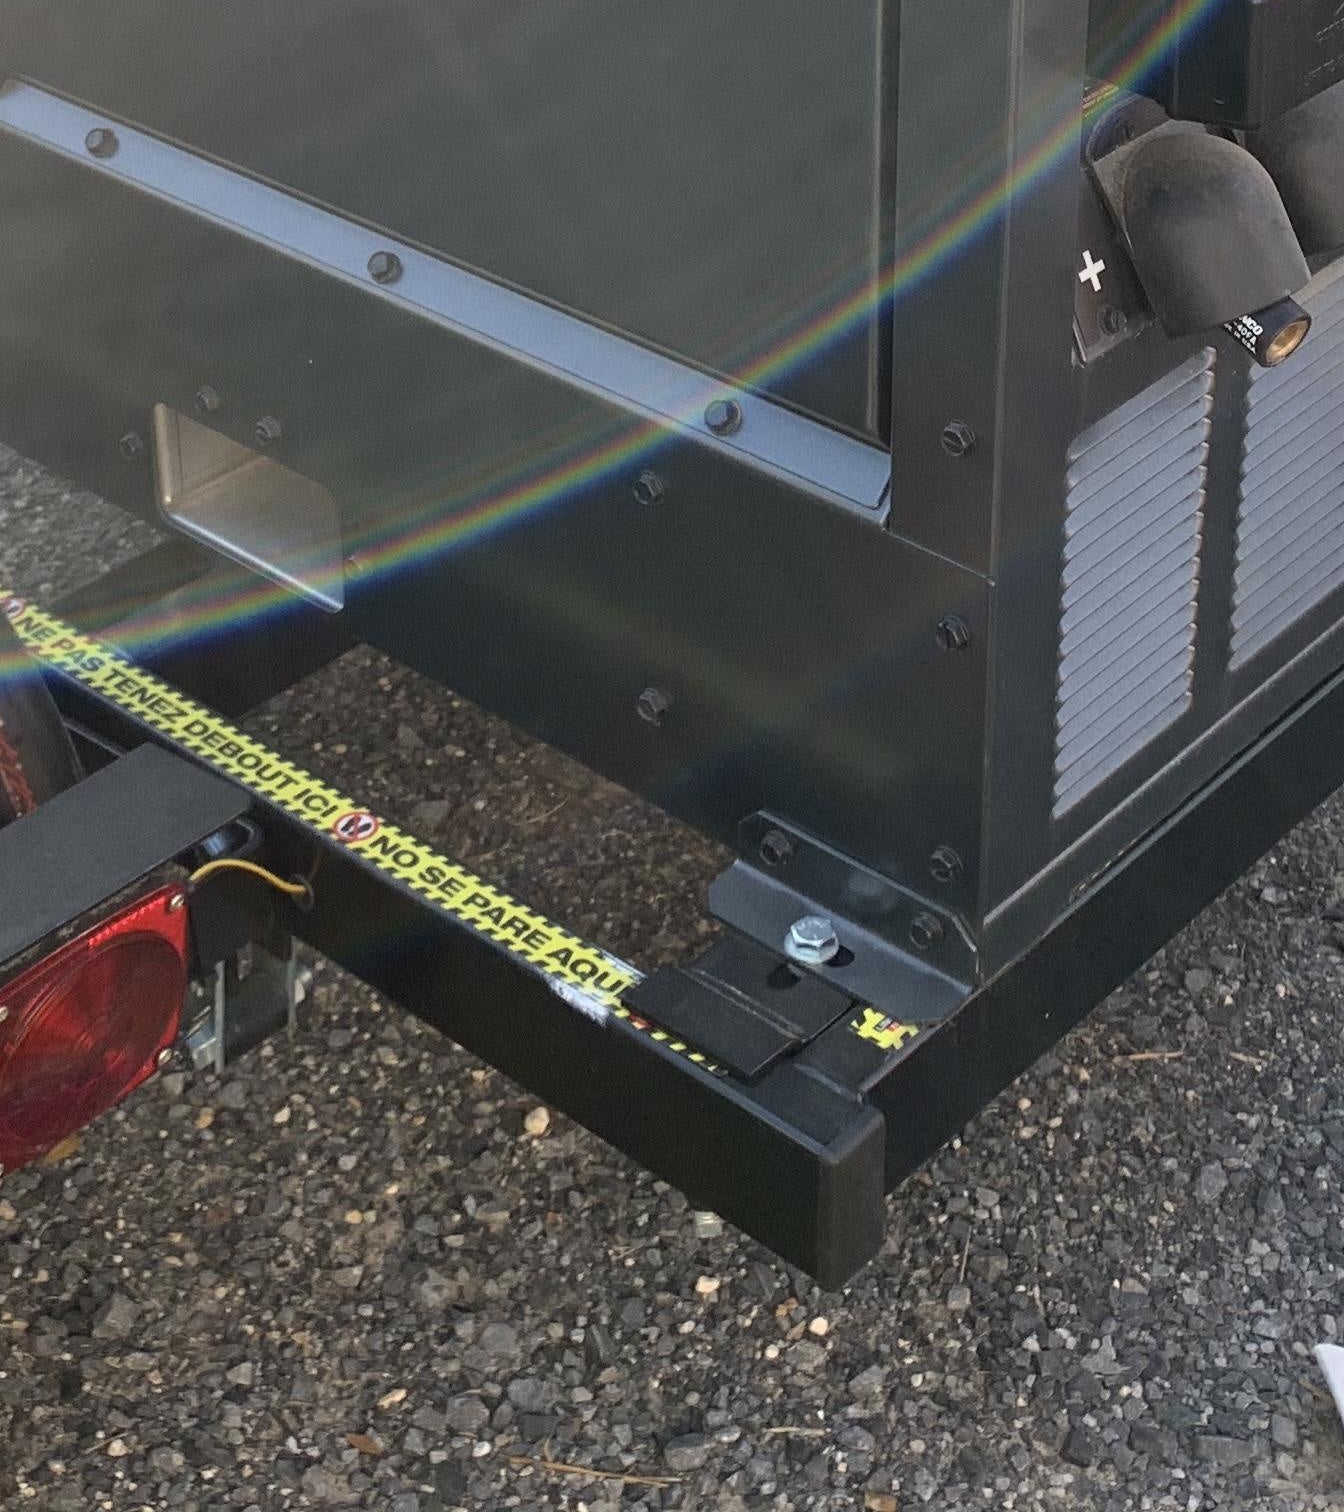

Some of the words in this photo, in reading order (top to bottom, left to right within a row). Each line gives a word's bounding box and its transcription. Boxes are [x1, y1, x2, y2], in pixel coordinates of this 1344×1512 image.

[14, 616, 56, 641] NE
[50, 636, 104, 673] PAS
[104, 667, 188, 725] TENEZ
[183, 719, 302, 791] DEBOUT
[293, 787, 340, 819] ICI
[368, 835, 420, 870] NO
[418, 865, 469, 898] SE
[462, 891, 552, 949] PARE
